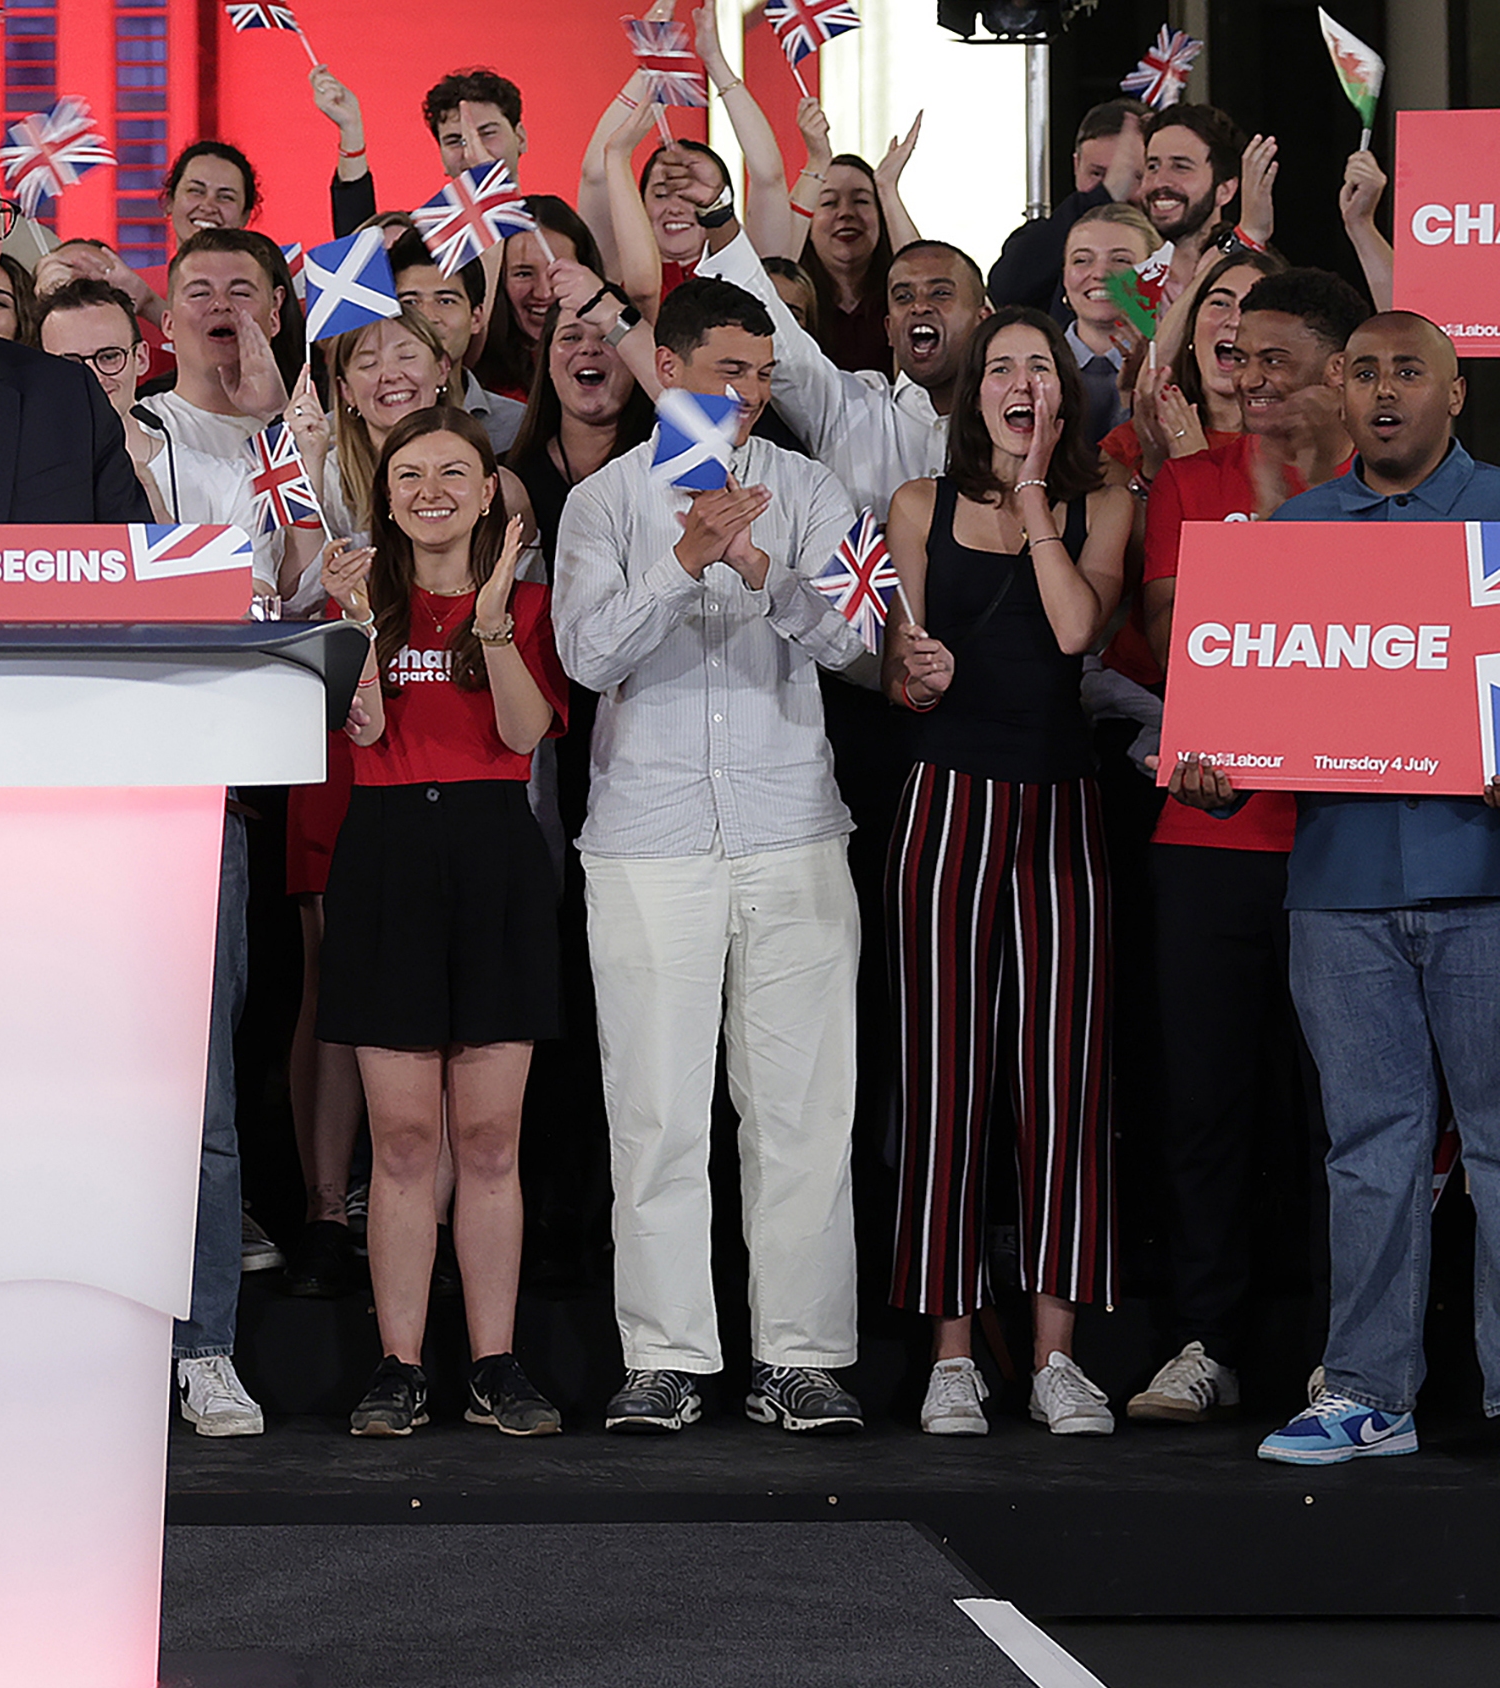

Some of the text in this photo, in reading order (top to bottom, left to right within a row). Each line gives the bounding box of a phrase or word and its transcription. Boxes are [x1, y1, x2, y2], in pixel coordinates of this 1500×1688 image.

[1187, 622, 1450, 670] CHANGE
[399, 669, 434, 686] part
[1230, 752, 1284, 768] Labour
[1313, 755, 1439, 775] Thursday 4 July
